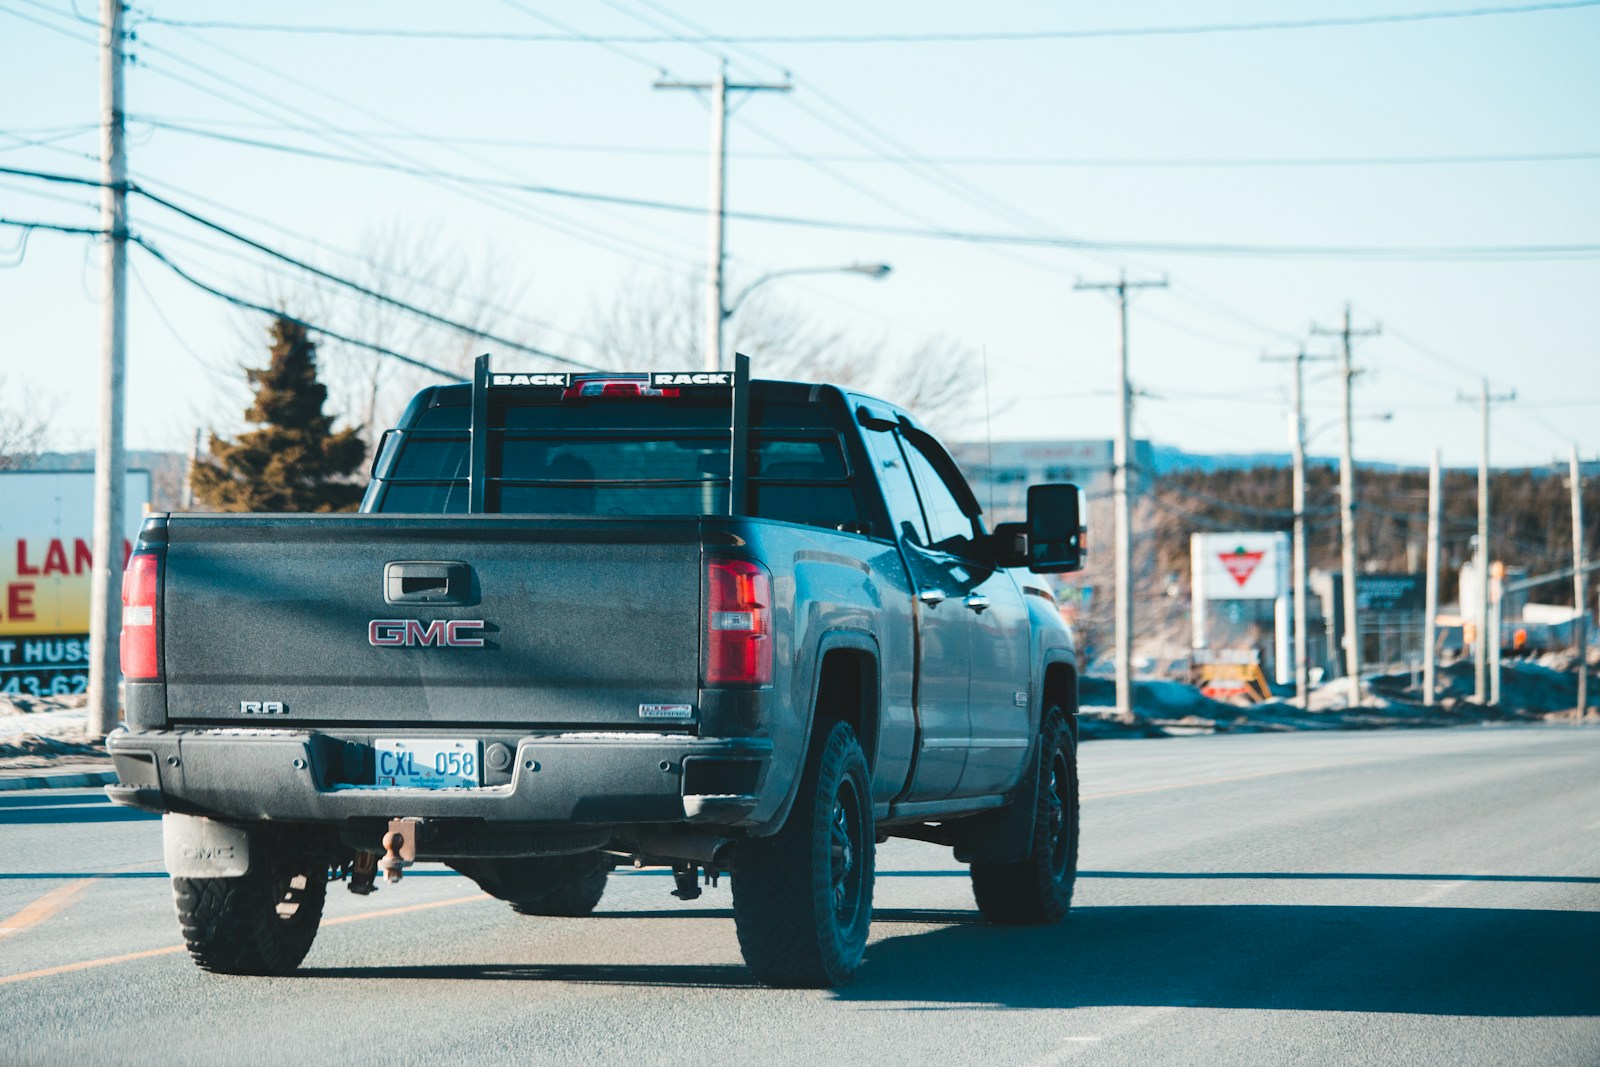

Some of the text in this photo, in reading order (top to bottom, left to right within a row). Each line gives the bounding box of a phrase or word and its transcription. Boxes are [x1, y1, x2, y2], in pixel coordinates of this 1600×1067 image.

[493, 374, 726, 386] BACK RACK
[0, 583, 36, 621] E
[368, 619, 485, 647] GMC
[0, 674, 88, 696] 43-62
[241, 701, 284, 714] RA
[380, 751, 475, 776] CXL 058
